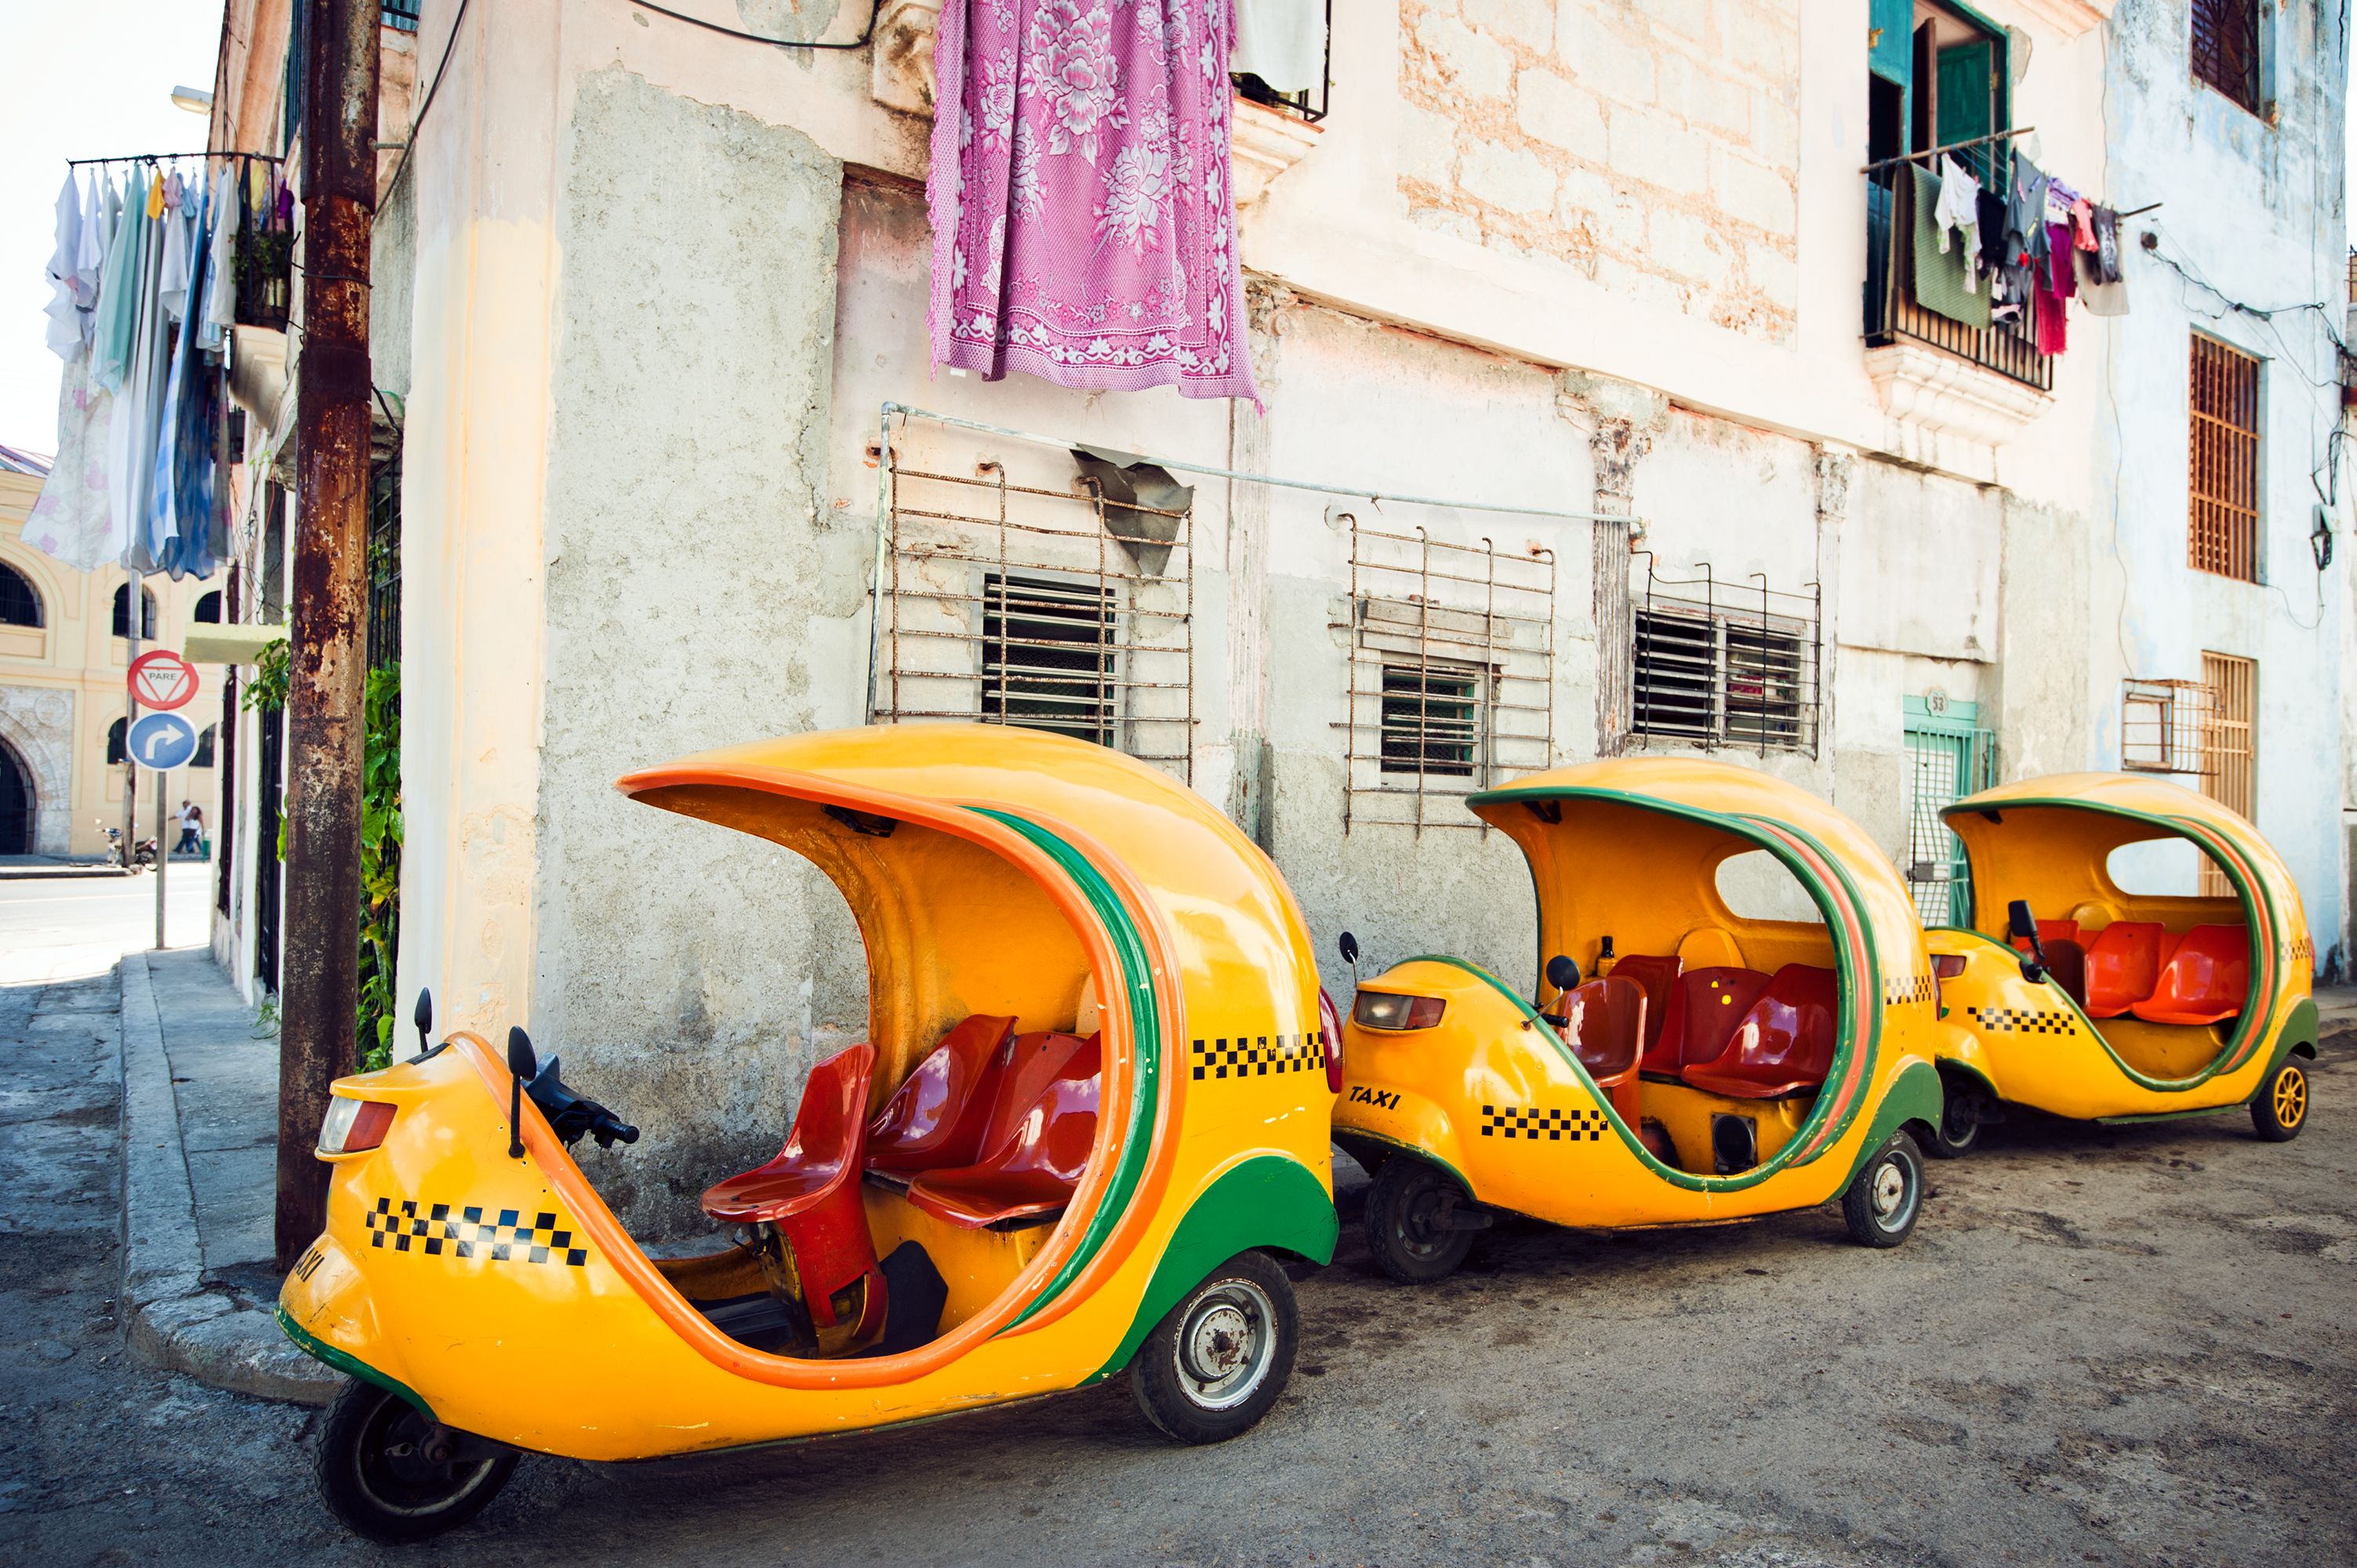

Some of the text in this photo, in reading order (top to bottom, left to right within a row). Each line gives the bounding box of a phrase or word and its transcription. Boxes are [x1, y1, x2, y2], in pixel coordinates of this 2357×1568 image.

[149, 672, 176, 681] PARE
[1933, 695, 1945, 712] 53
[1349, 1086, 1401, 1110] TAXI
[294, 1244, 325, 1283] AXI
